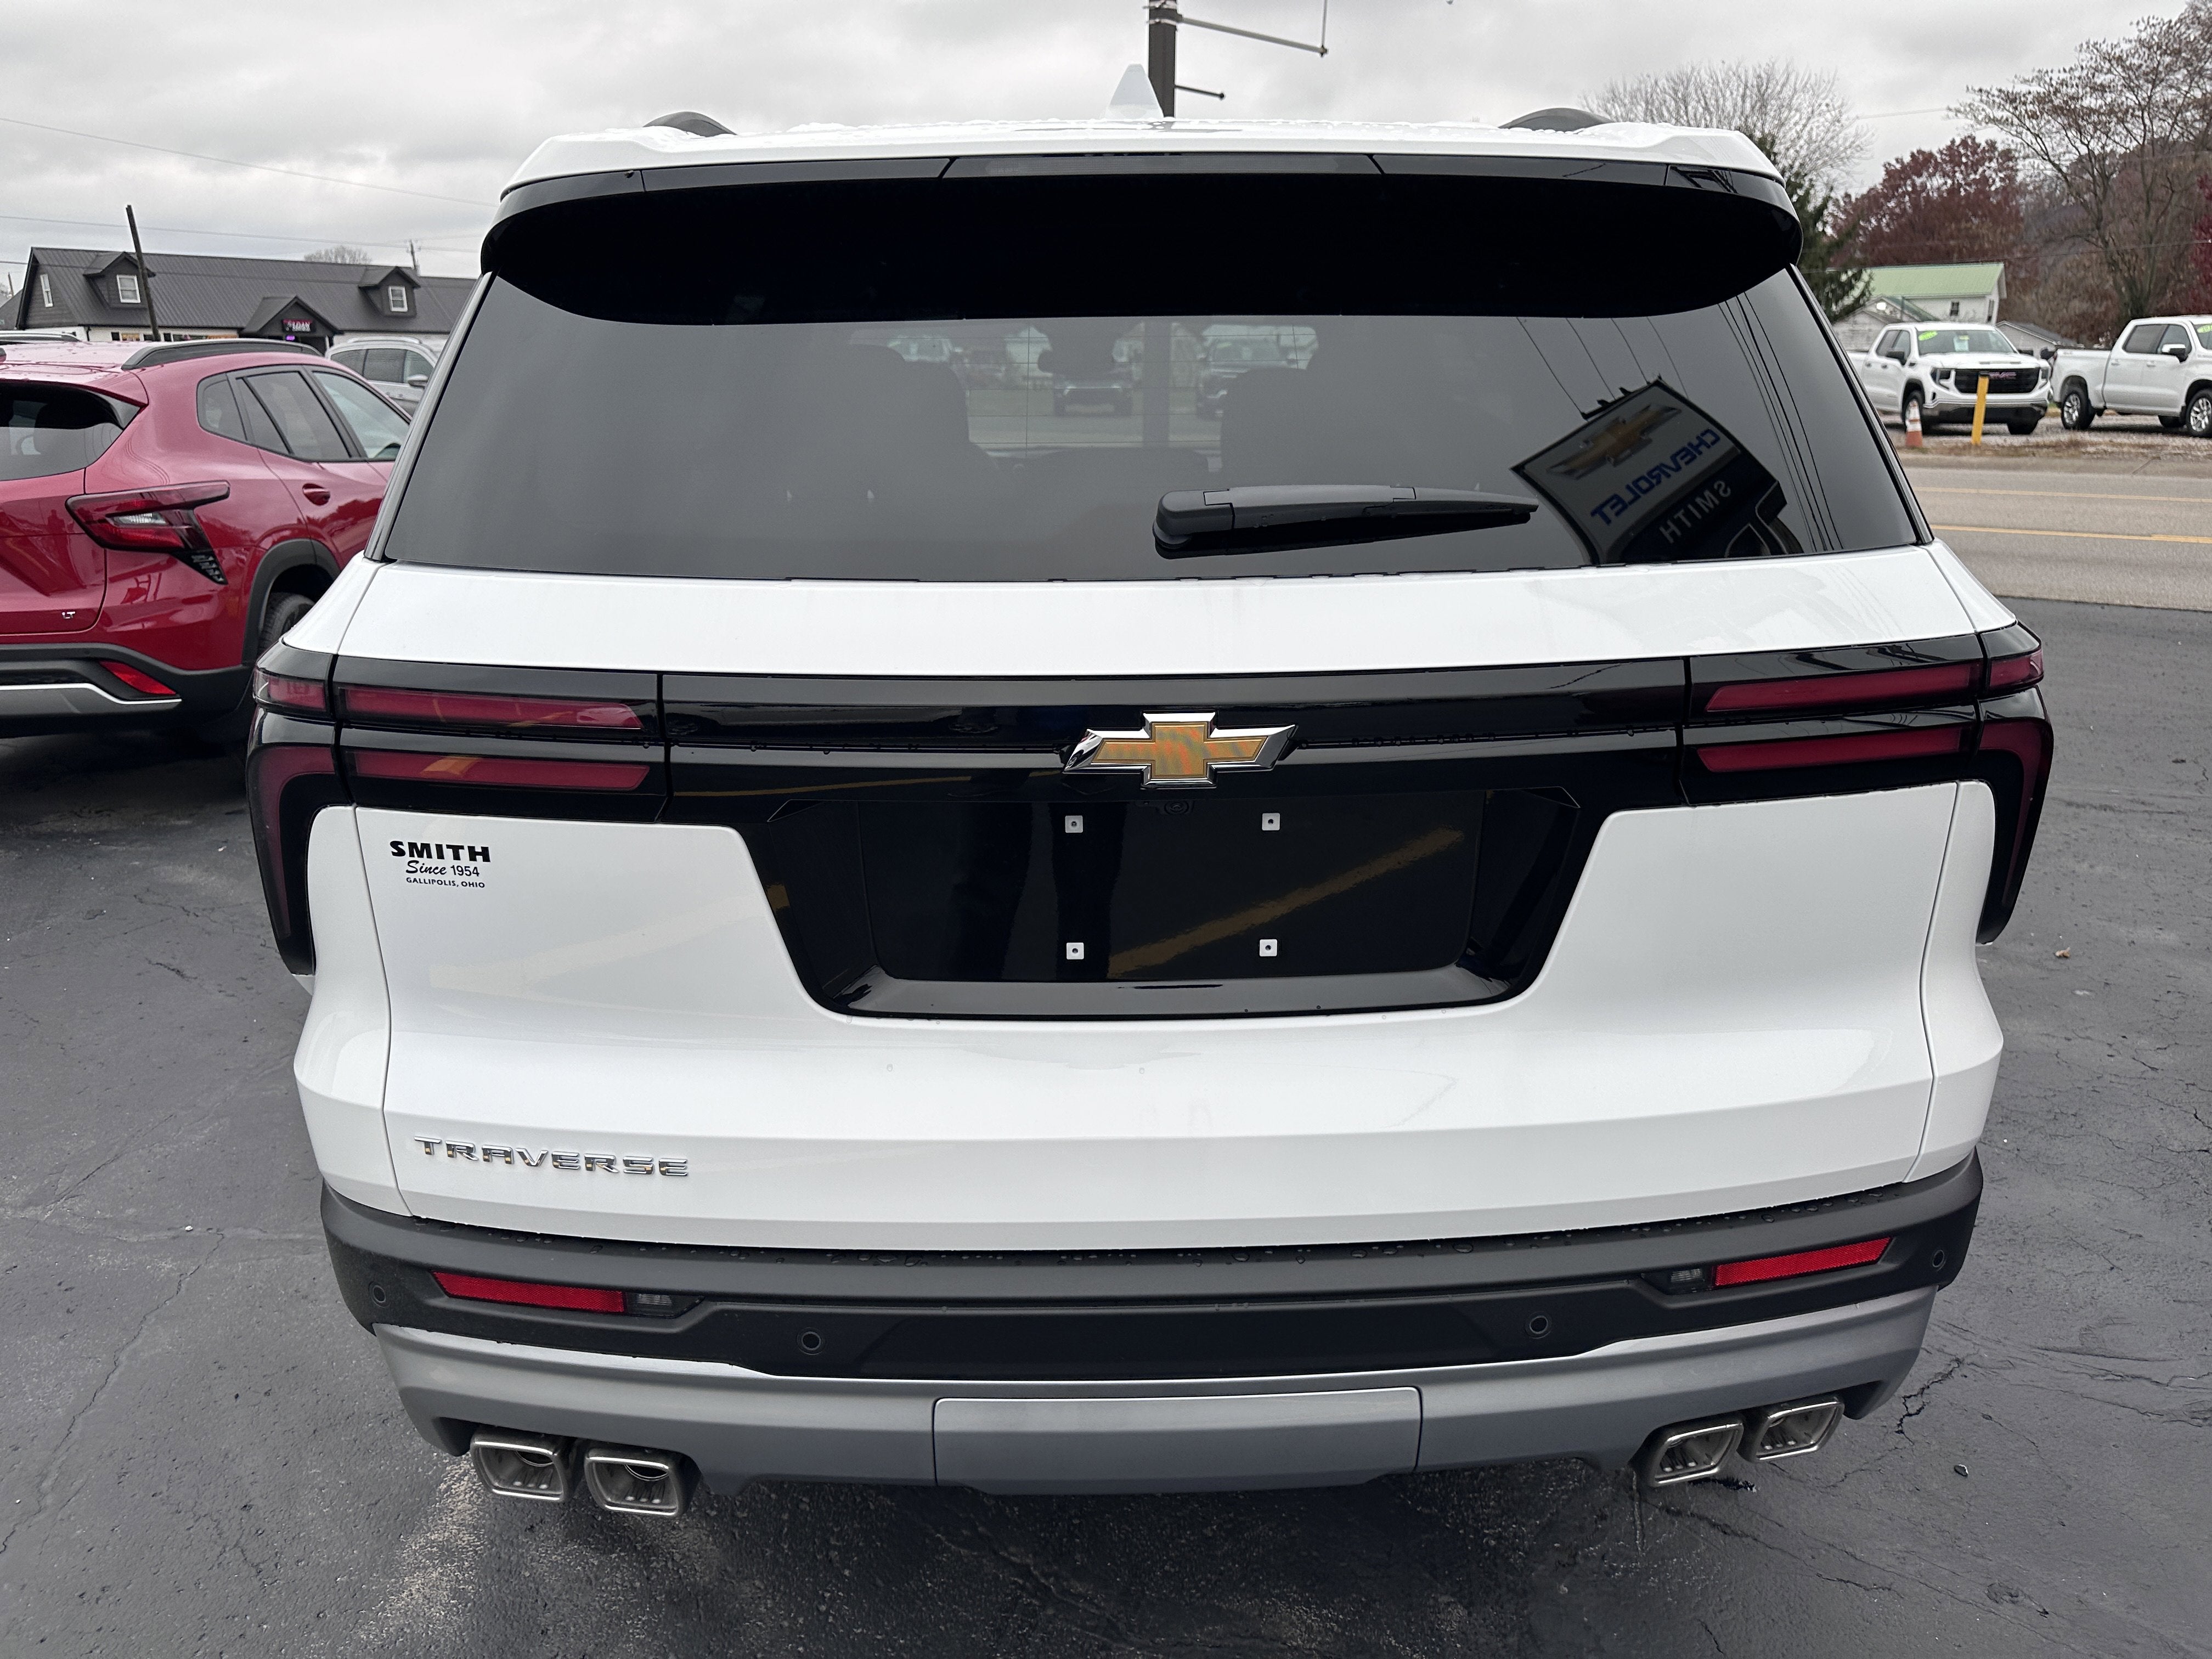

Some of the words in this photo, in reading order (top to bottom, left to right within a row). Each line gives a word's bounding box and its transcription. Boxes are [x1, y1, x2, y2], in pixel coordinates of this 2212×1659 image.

[61, 611, 76, 619] LT
[390, 840, 491, 862] SMITH
[405, 860, 447, 875] Since
[450, 865, 480, 877] 1954
[406, 877, 459, 887] GALLIPOLIS,
[414, 1136, 689, 1177] TRAVERSE
